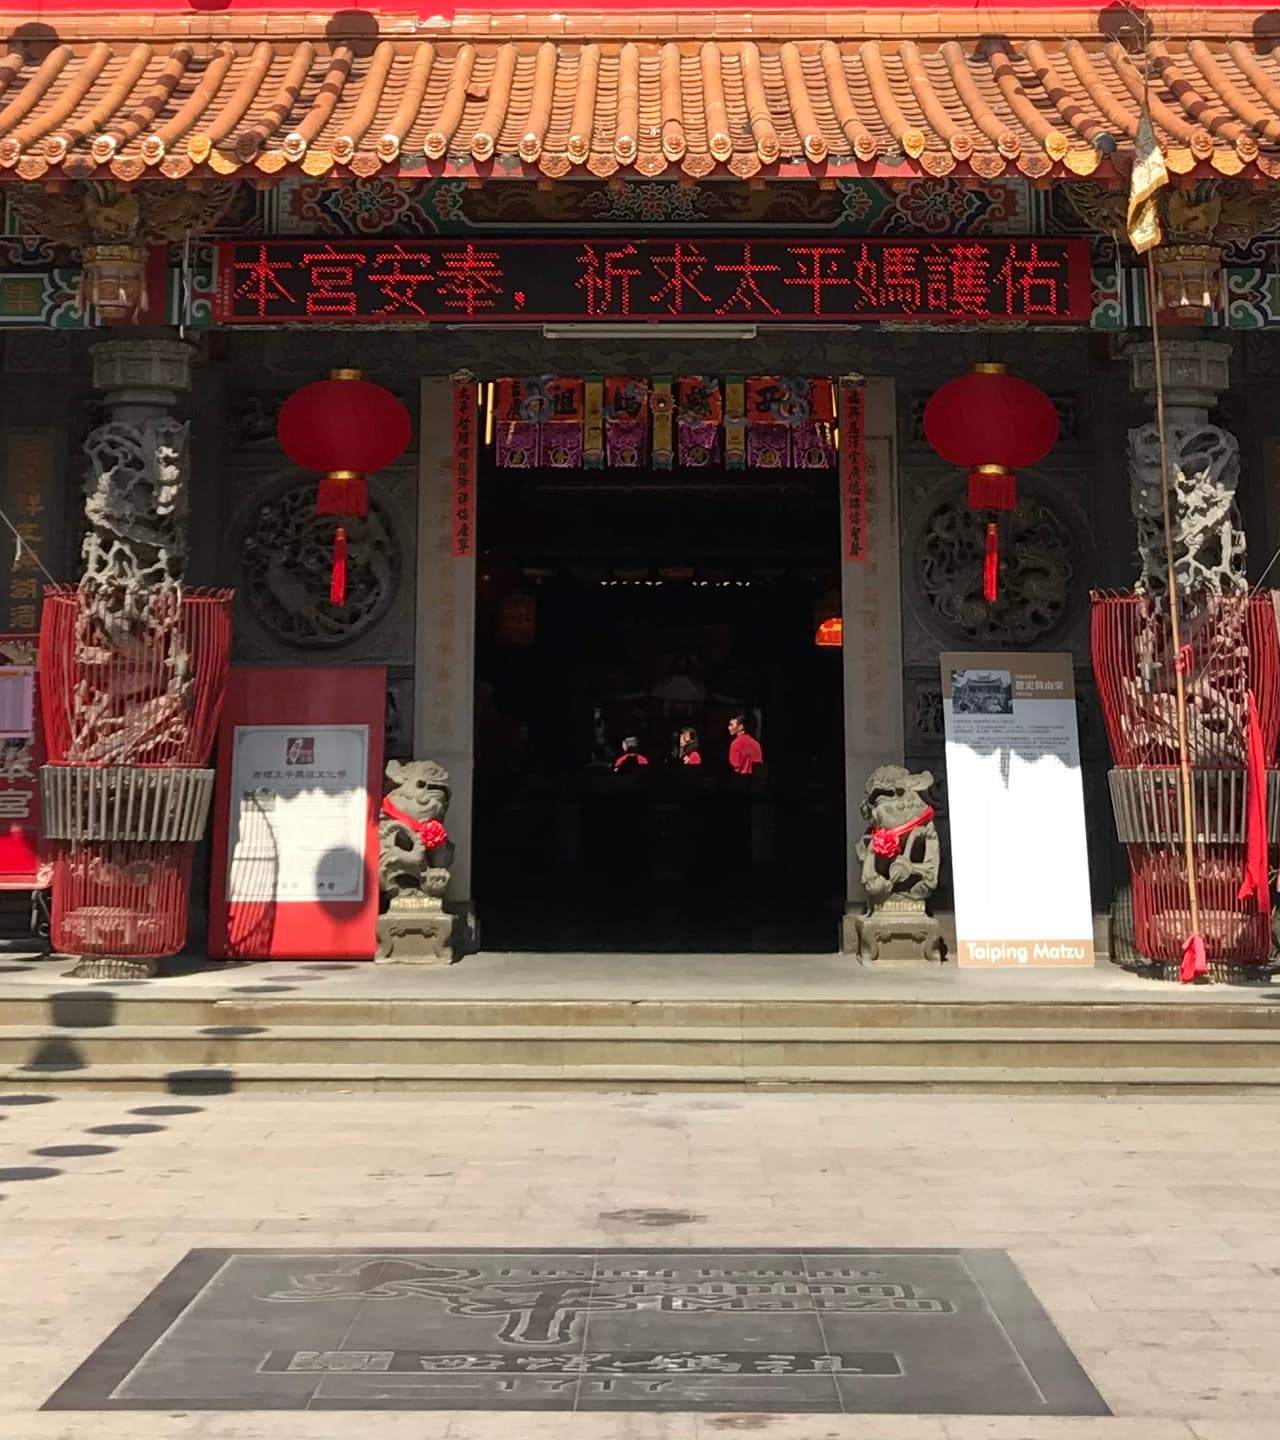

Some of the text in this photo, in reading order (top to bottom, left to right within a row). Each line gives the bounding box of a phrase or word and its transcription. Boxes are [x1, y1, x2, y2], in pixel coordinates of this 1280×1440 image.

[576, 244, 1067, 315] 祈求太平媽護佑
[966, 942, 1085, 962] Taiping Matzu
[631, 1280, 908, 1298] Taiping
[494, 1379, 674, 1392] 1717
